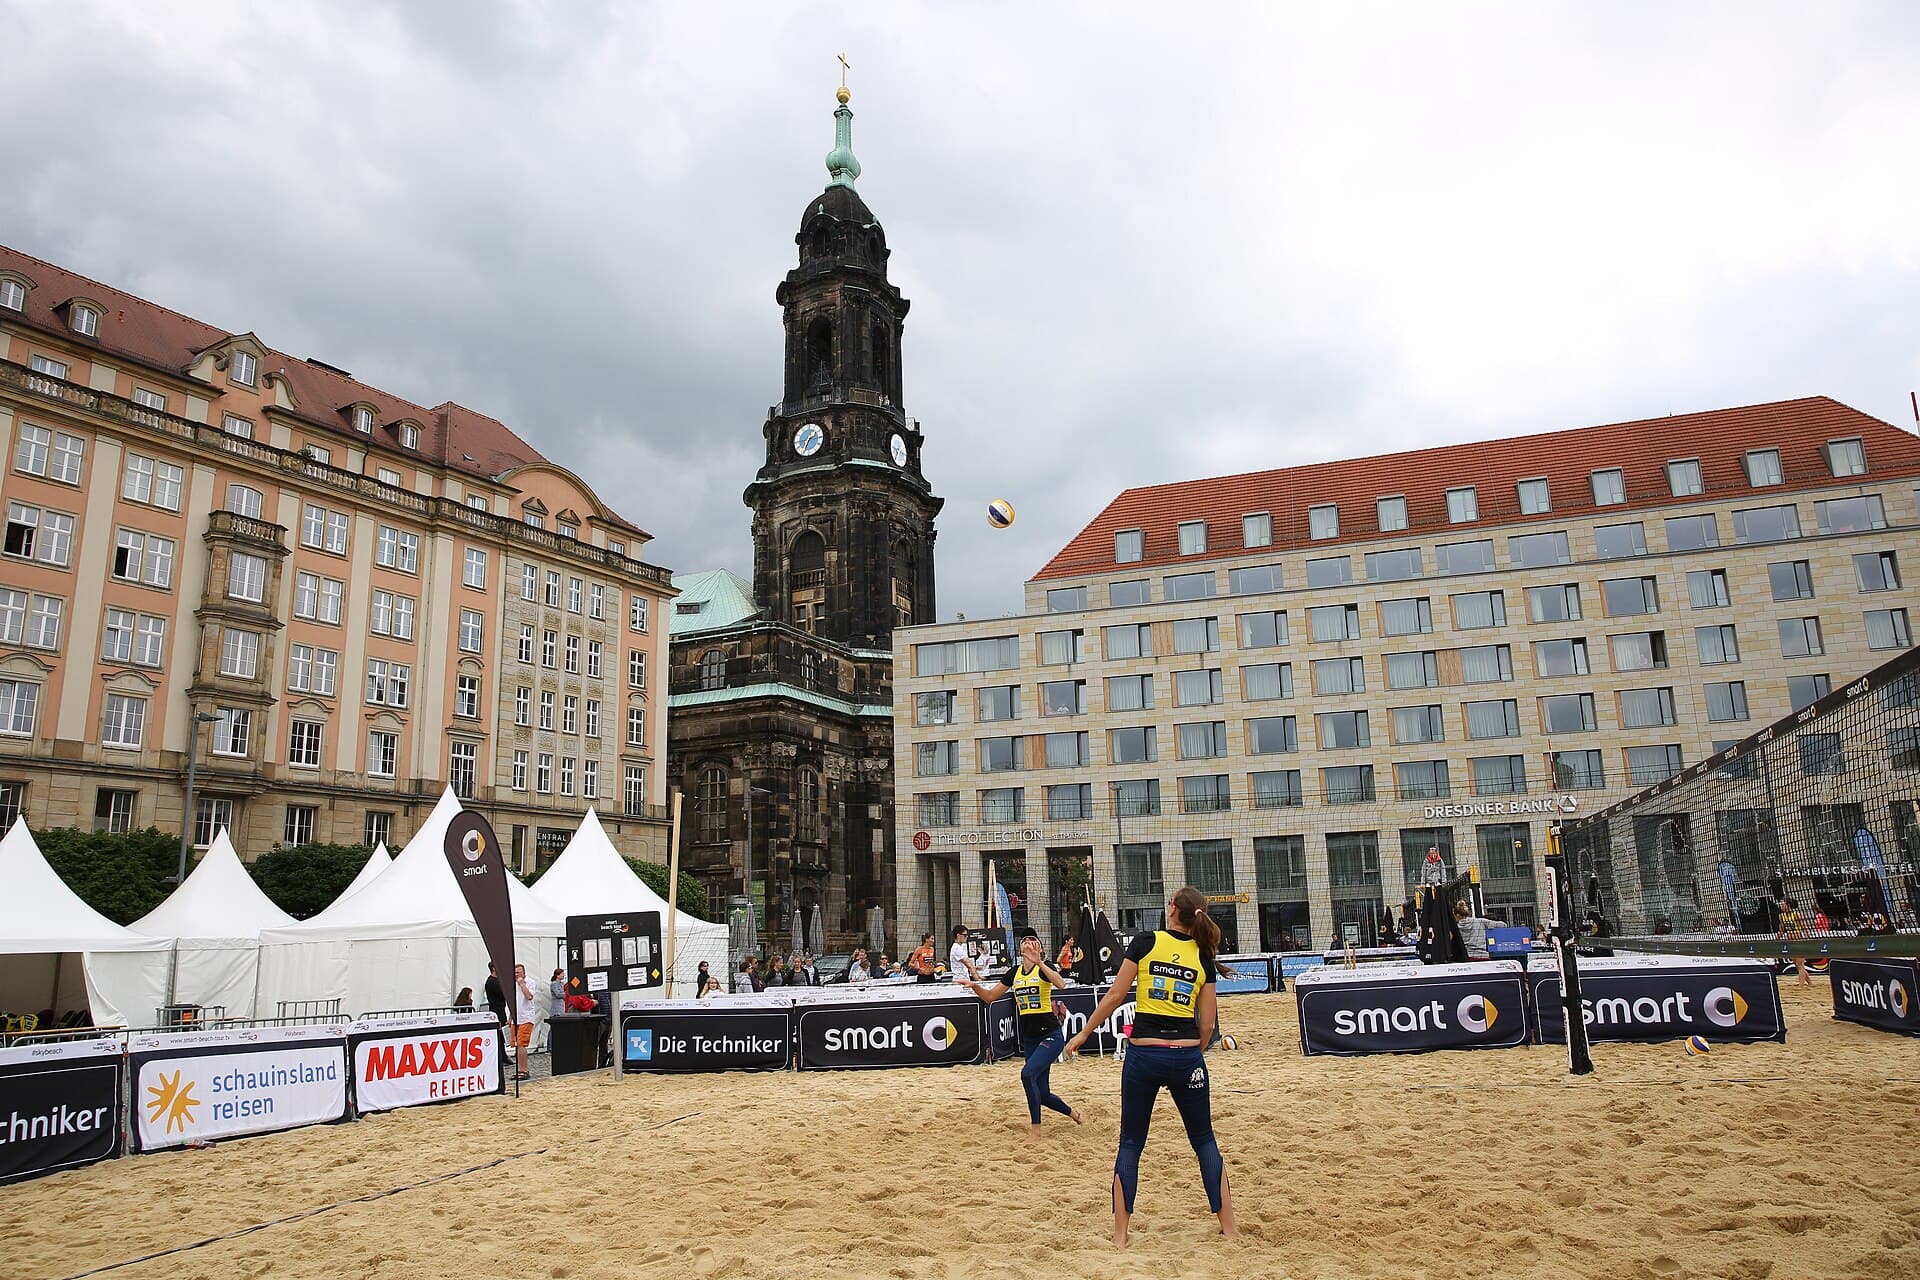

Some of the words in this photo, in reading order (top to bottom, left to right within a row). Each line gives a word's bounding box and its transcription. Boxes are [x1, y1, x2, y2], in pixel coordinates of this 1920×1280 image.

[1846, 682, 1863, 698] smart
[1797, 708, 1811, 723] smart
[1424, 802, 1504, 819] DRESDNER
[1510, 799, 1553, 814] BANK
[959, 829, 1043, 844] COLLECTION
[463, 864, 488, 877] smart
[1172, 953, 1181, 964] 2
[1153, 965, 1182, 977] smart
[1176, 994, 1189, 1004] sky
[1841, 979, 1888, 1010] smart
[1334, 1000, 1446, 1035] smart
[1581, 991, 1693, 1024] smart
[659, 1036, 687, 1053] Die
[692, 1035, 782, 1054] Techniker
[824, 1021, 913, 1051] smart
[365, 1037, 483, 1082] MAXXIS
[212, 1060, 337, 1093] schauinsland
[429, 1075, 486, 1099] REIFEN
[212, 1095, 274, 1120] reisen
